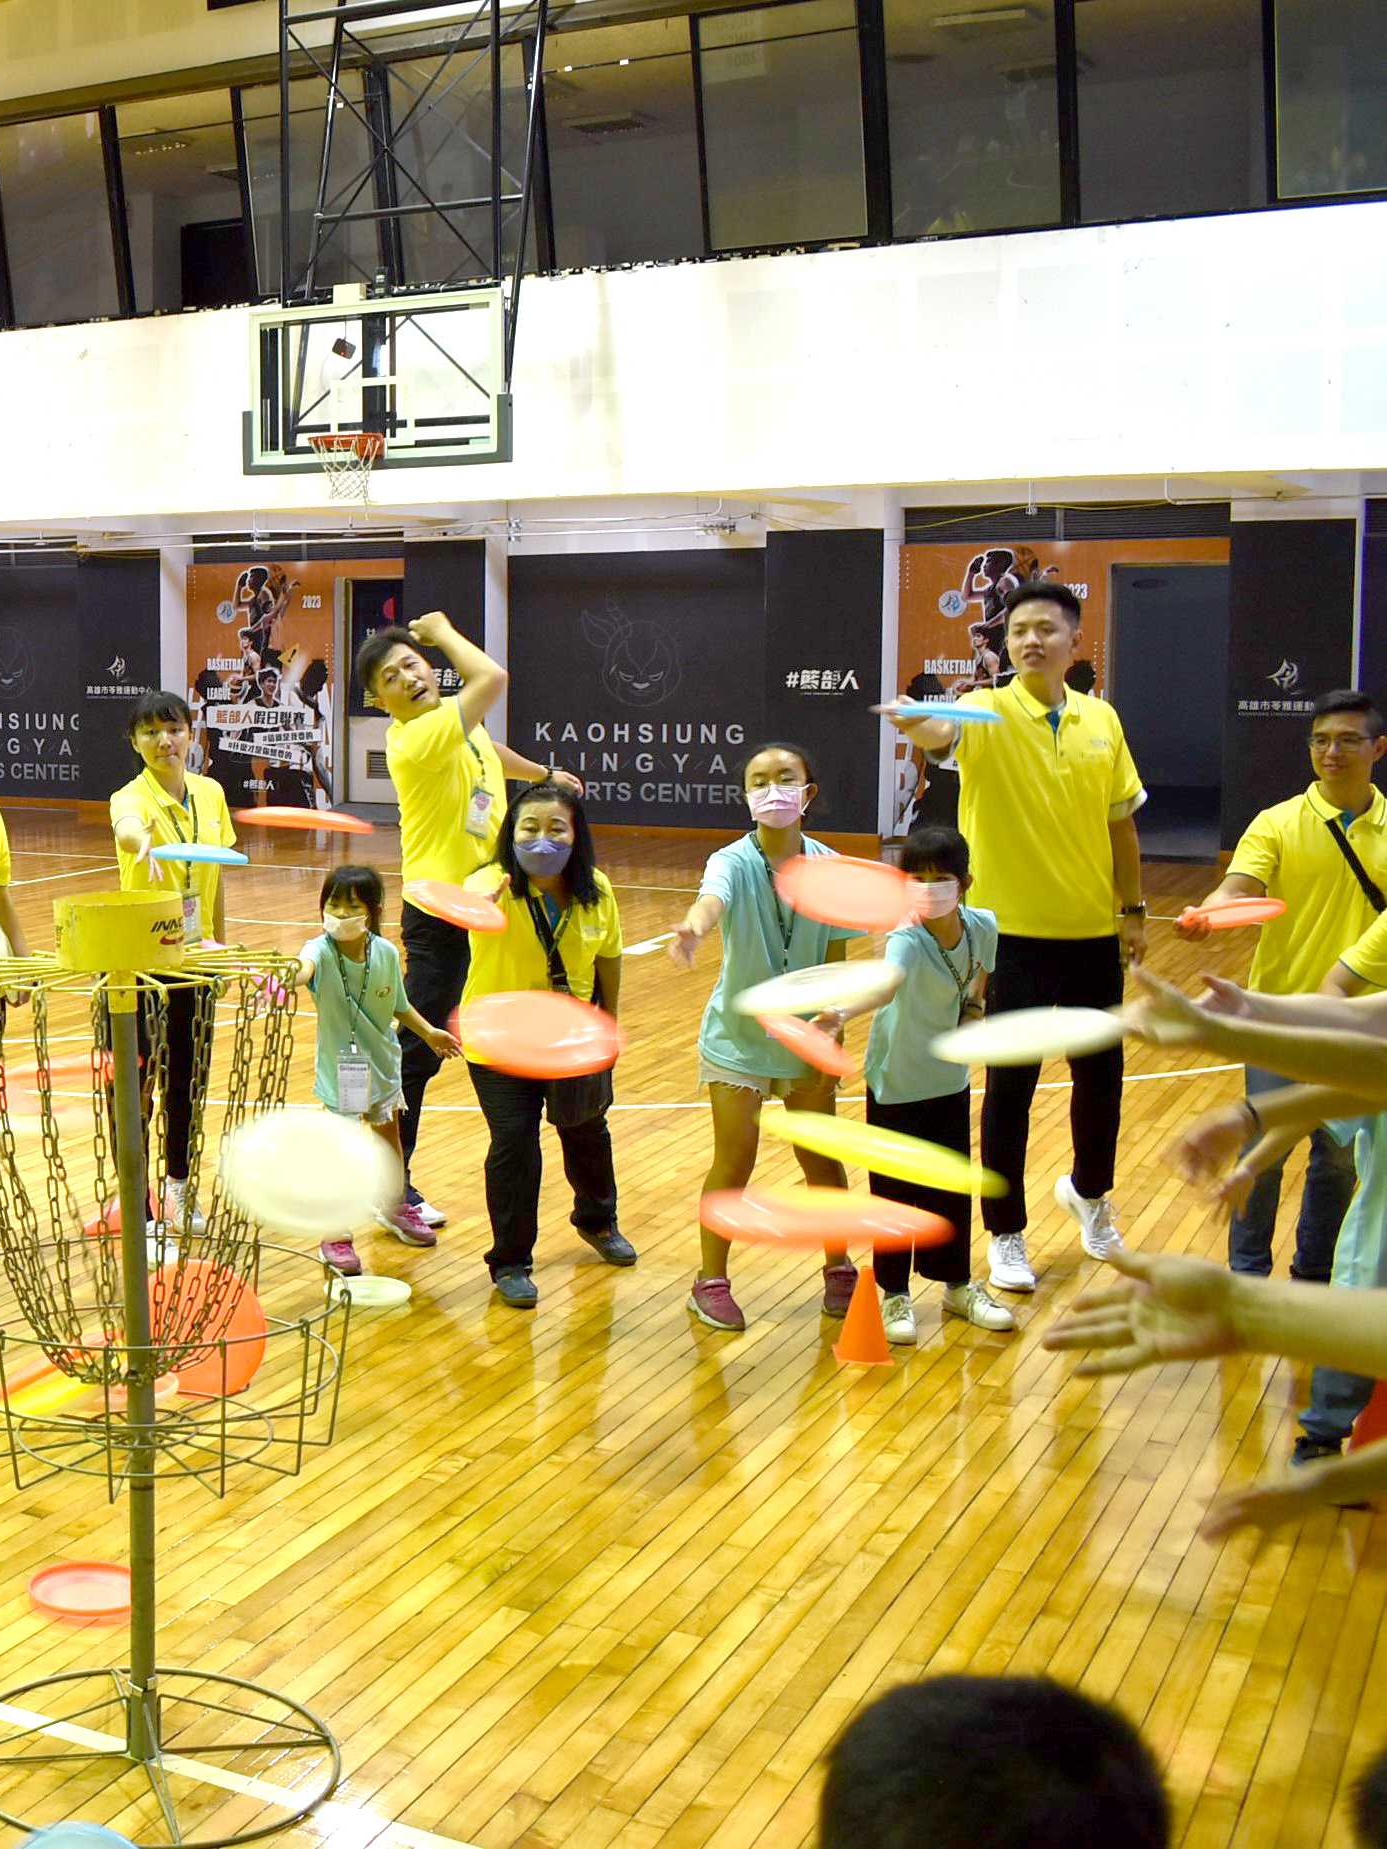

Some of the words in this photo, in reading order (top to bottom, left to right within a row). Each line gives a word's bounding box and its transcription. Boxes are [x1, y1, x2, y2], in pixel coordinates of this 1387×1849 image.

[1063, 583, 1088, 600] 023
[302, 595, 322, 609] 2023
[1238, 700, 1315, 712] 高雄市苓雅運動
[534, 722, 745, 744] KAOHSIUNG
[549, 751, 728, 775] LINGYA
[639, 782, 743, 805] CENTER
[150, 916, 184, 933] INN
